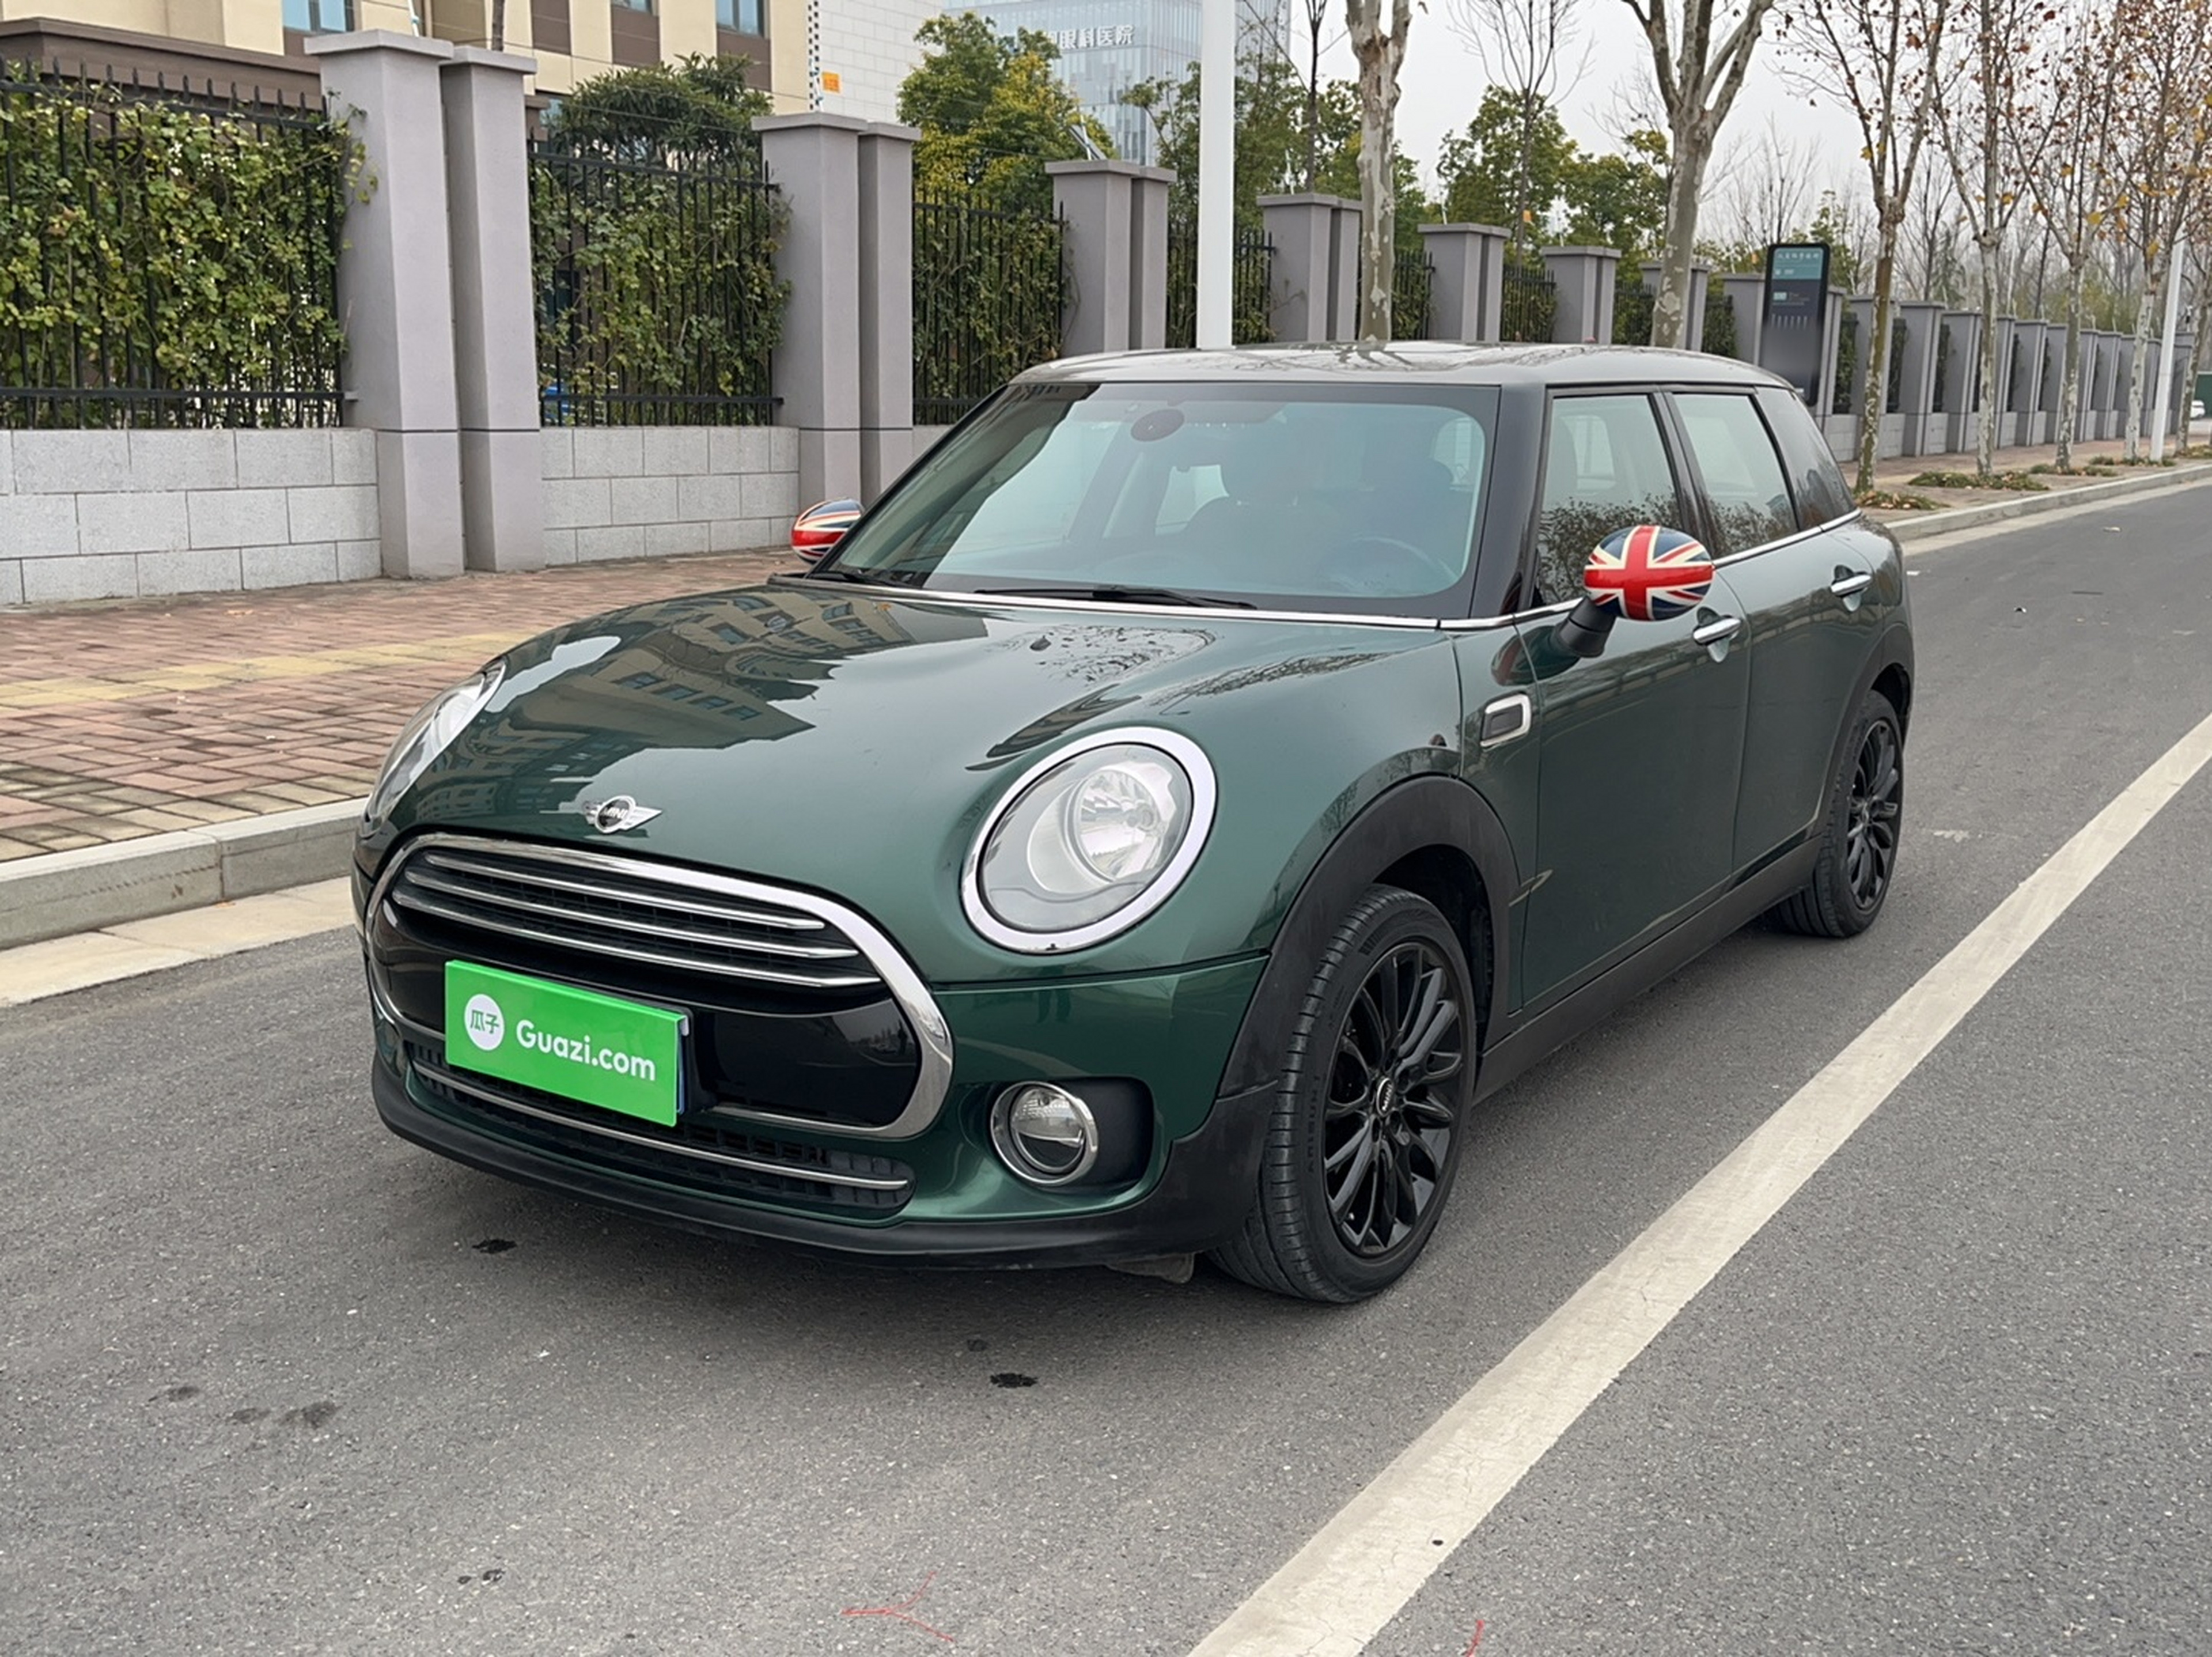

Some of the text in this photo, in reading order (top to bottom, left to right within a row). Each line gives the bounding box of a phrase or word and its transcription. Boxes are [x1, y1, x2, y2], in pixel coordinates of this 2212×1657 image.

[601, 806, 628, 819] MINI
[469, 1009, 500, 1034] 瓜子
[517, 1019, 656, 1081] Guazi.com
